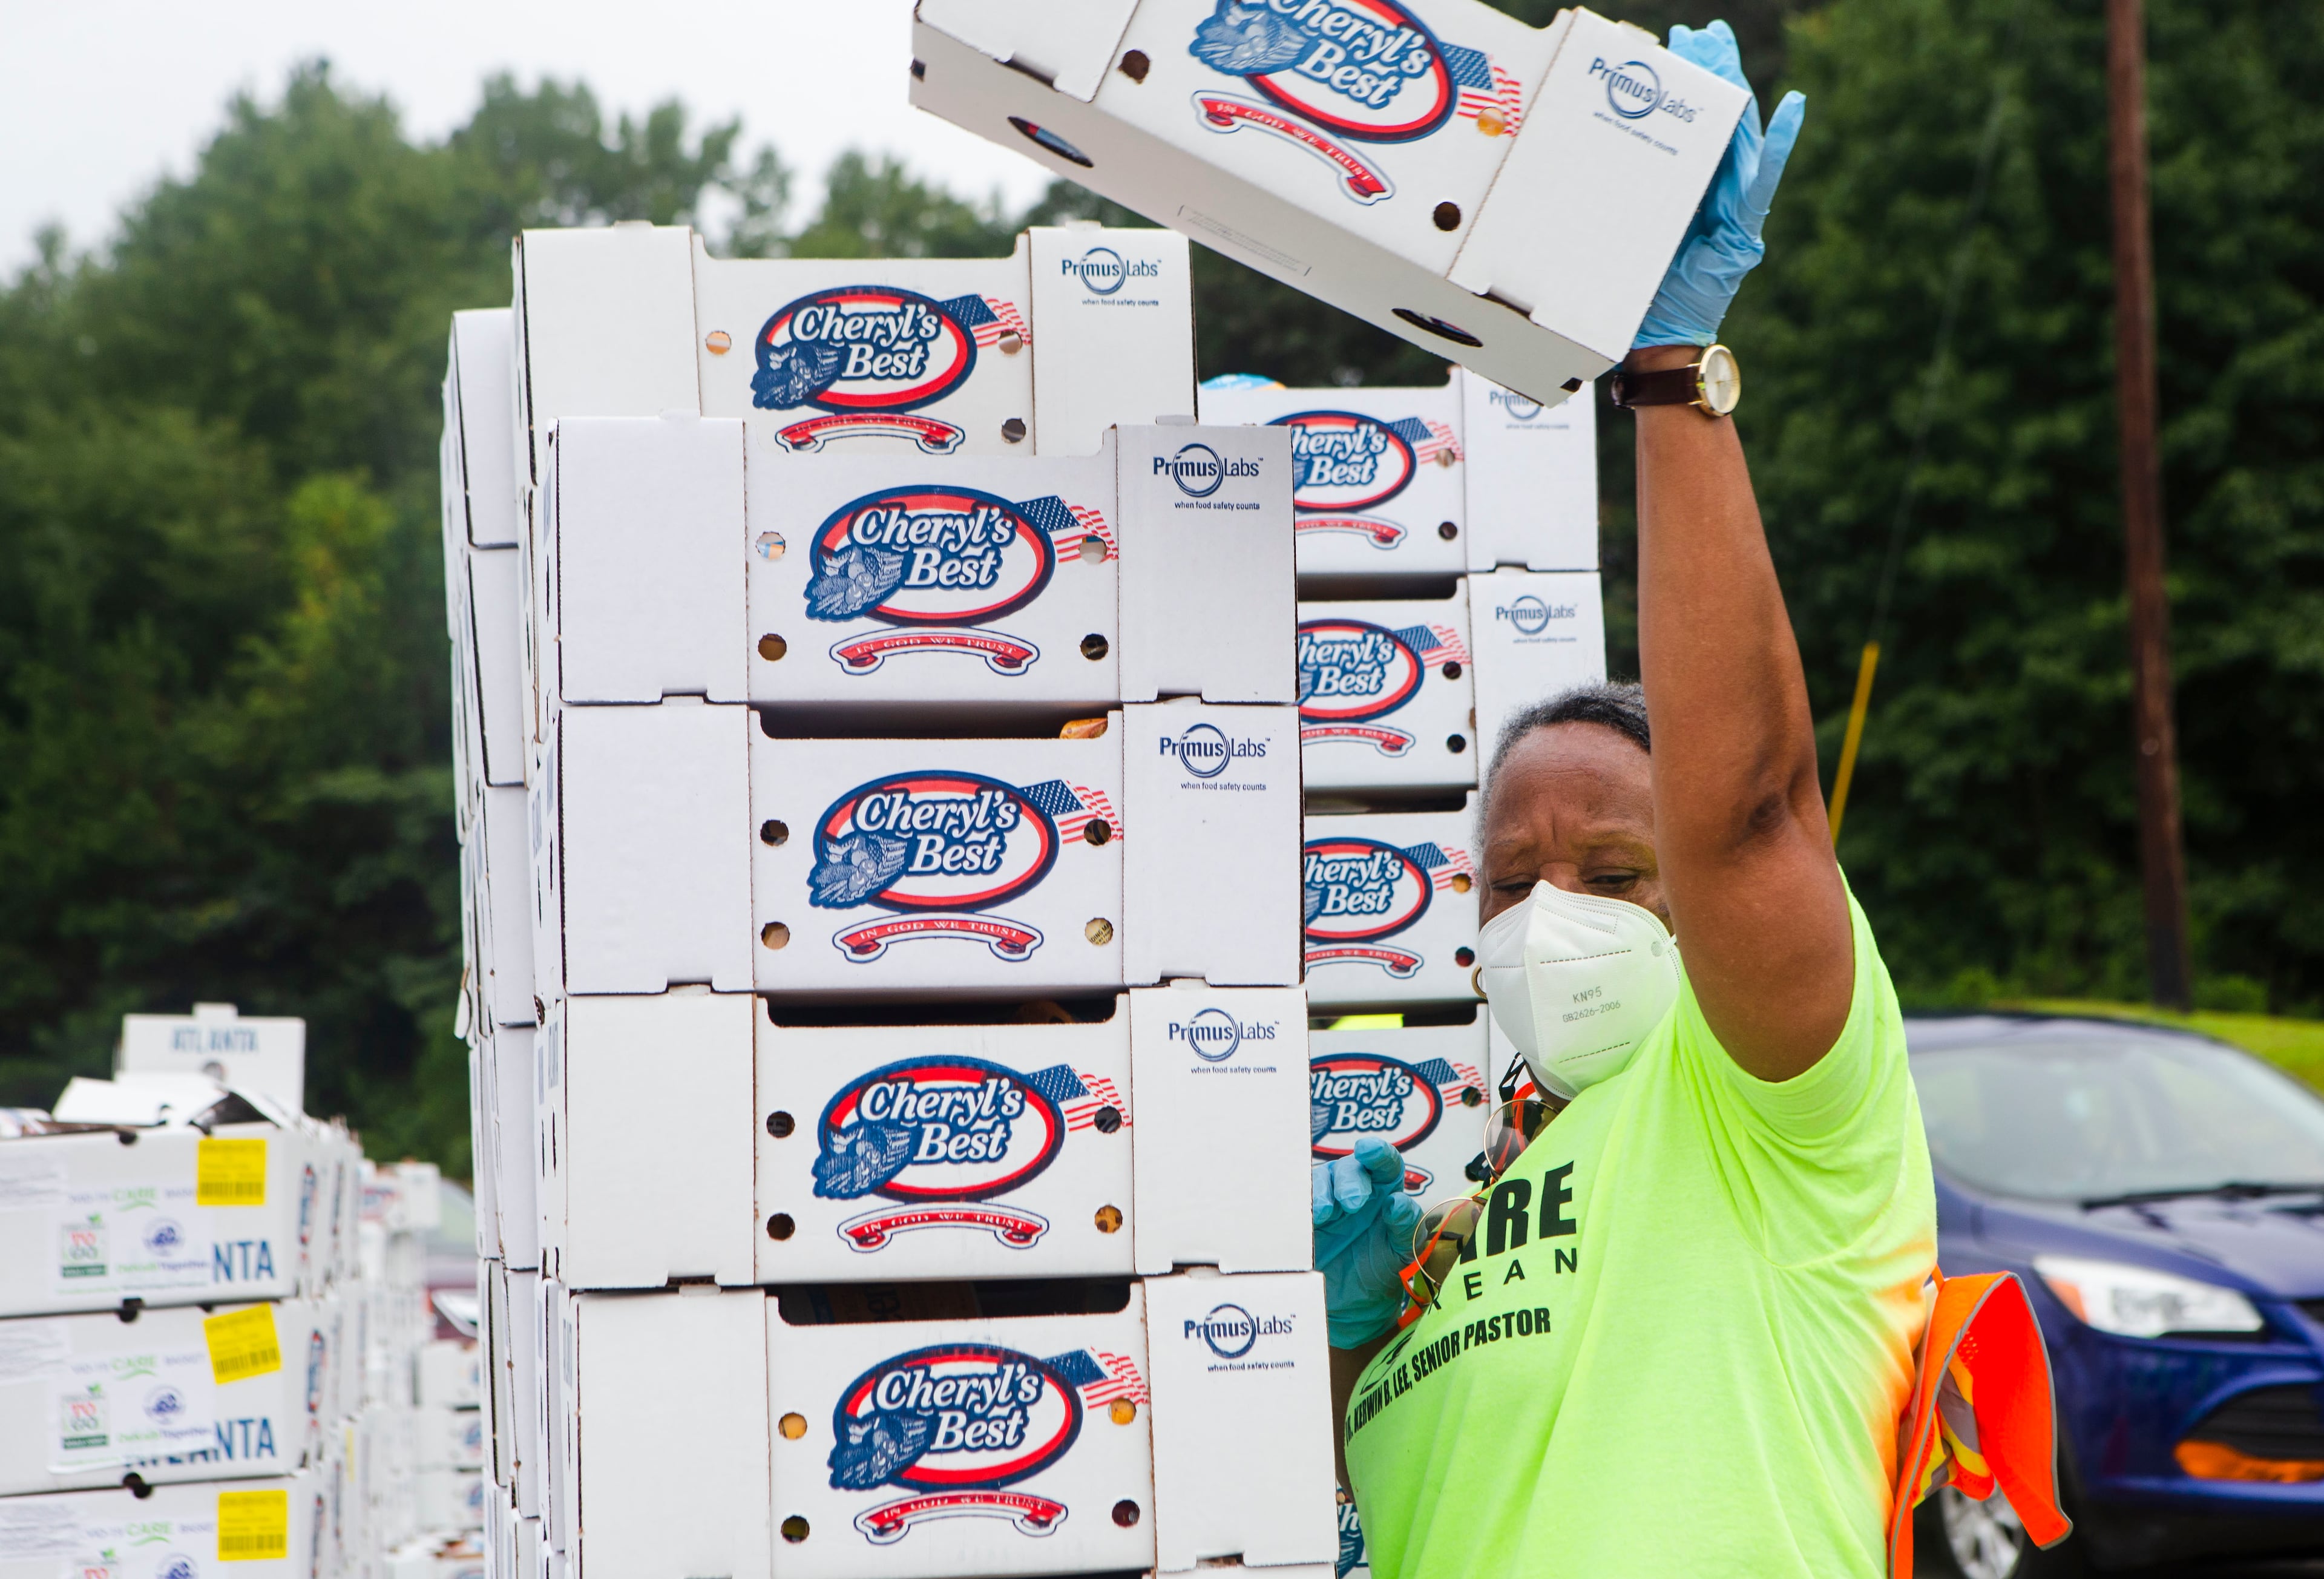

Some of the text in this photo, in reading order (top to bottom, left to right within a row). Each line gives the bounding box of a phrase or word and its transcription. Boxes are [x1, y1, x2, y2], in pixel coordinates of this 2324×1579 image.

[1295, 39, 1401, 106] Best
[1117, 299, 1136, 307] safety
[793, 304, 938, 347] Cheryl's
[842, 340, 925, 378] Best
[1292, 424, 1387, 460] heryl's
[1307, 457, 1374, 485] Best
[1196, 501, 1211, 510] food
[1213, 501, 1235, 511] safety
[1236, 502, 1260, 510] counts
[853, 506, 1013, 553] Cheryl's
[905, 547, 999, 586] Best
[857, 637, 1017, 655] IN GOD WE TRUST
[1299, 633, 1394, 669] heryl's
[1314, 666, 1383, 694] Best
[1219, 783, 1241, 792] safety
[856, 790, 1017, 838] Cheryl's
[908, 834, 1002, 872] Best
[1305, 852, 1402, 887] heryl's
[1321, 884, 1391, 914] Best
[859, 921, 1022, 940] IN GOD WE TRUST
[1563, 1000, 1621, 1023] GB2626-2006
[1573, 986, 1602, 1003] KN95
[861, 1078, 1023, 1126] Cheryl's
[1312, 1067, 1412, 1103] heryl's
[1331, 1101, 1400, 1130] Best
[913, 1123, 1007, 1161] Best
[1207, 1364, 1228, 1373] when
[1229, 1363, 1246, 1371] food
[1247, 1362, 1269, 1370] safety
[1354, 1384, 1383, 1434] KERWIN
[1383, 1379, 1393, 1407] B.
[1393, 1363, 1413, 1399] LEE,
[1411, 1330, 1460, 1382] SENIOR
[1464, 1307, 1551, 1351] PASTOR
[877, 1364, 1039, 1414] Cheryl's
[930, 1410, 1024, 1450] Best
